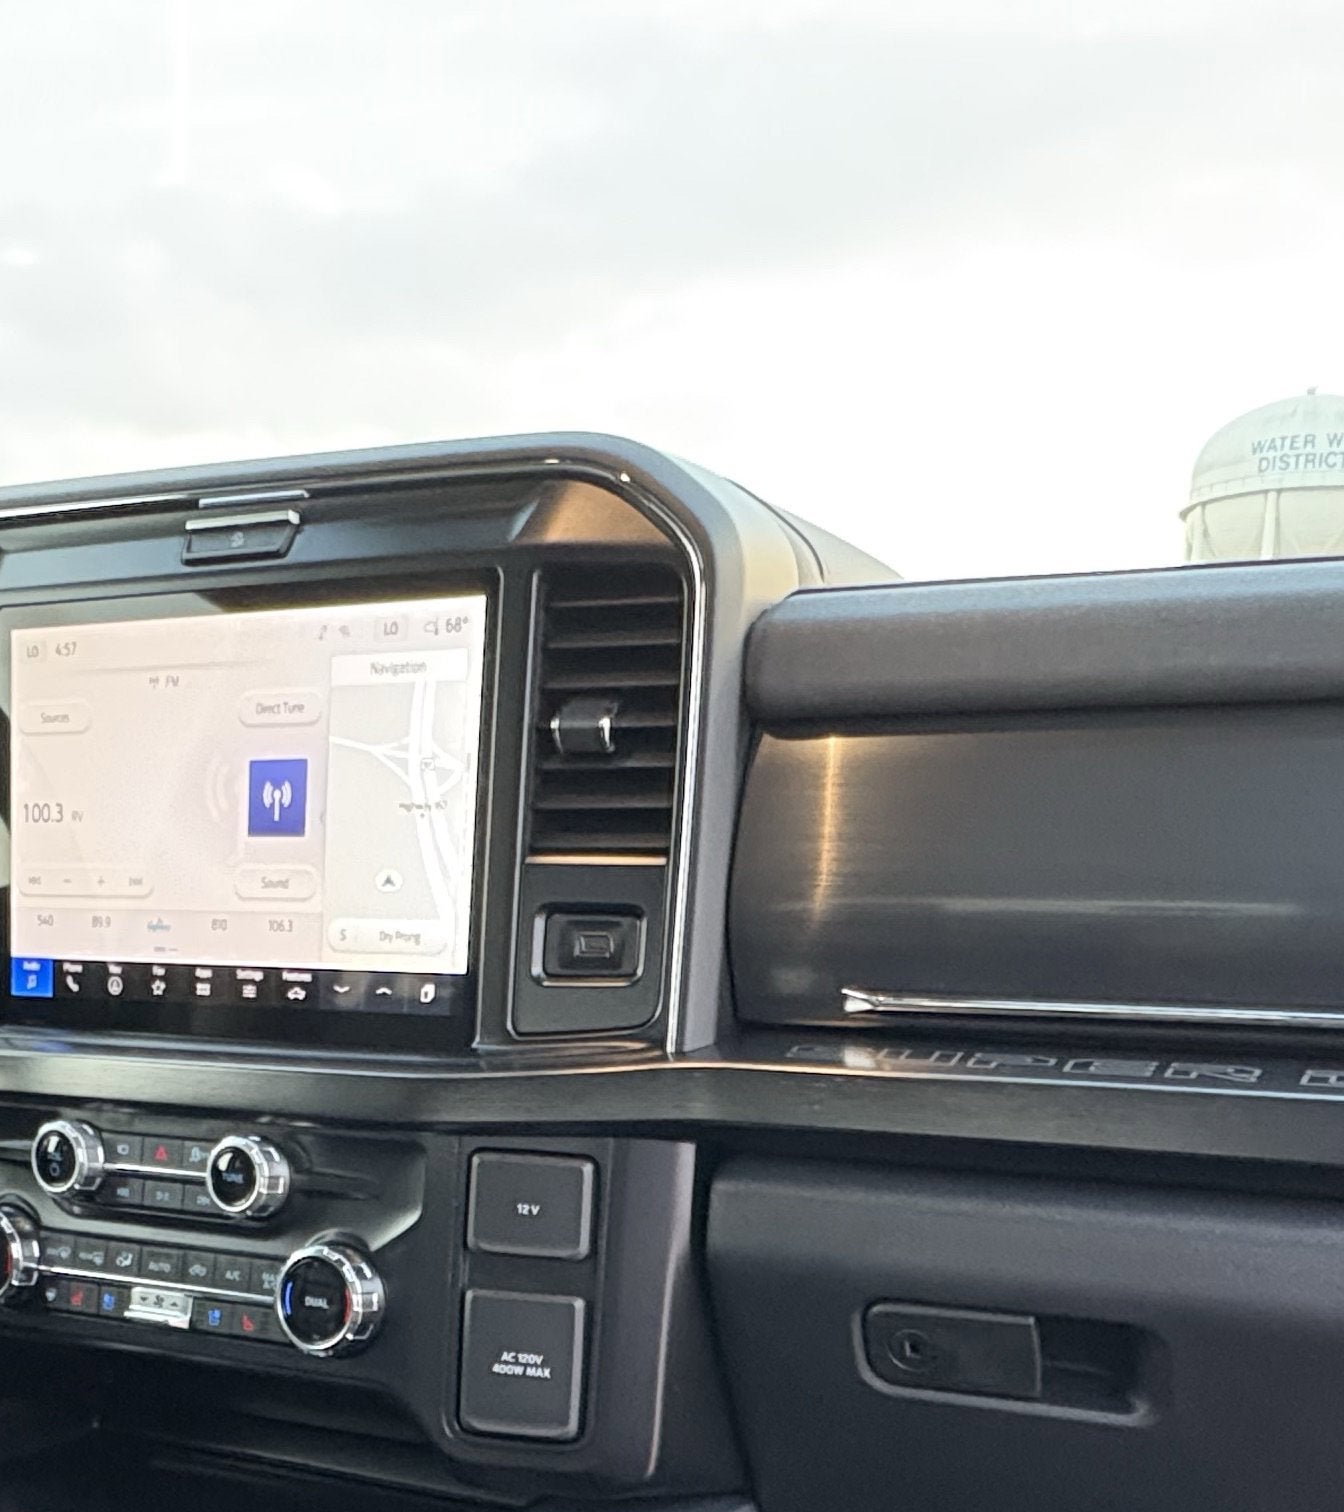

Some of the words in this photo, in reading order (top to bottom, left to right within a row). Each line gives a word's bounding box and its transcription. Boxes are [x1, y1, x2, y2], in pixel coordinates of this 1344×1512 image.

[1251, 433, 1317, 456] WATER
[383, 621, 399, 635] LO
[370, 661, 427, 677] Navigation
[23, 803, 64, 824] 100.3
[786, 1044, 1262, 1083] SUPER
[501, 1351, 516, 1363] AC
[517, 1352, 545, 1365] 120V
[491, 1363, 525, 1376] 400W
[526, 1366, 552, 1379] MAX
